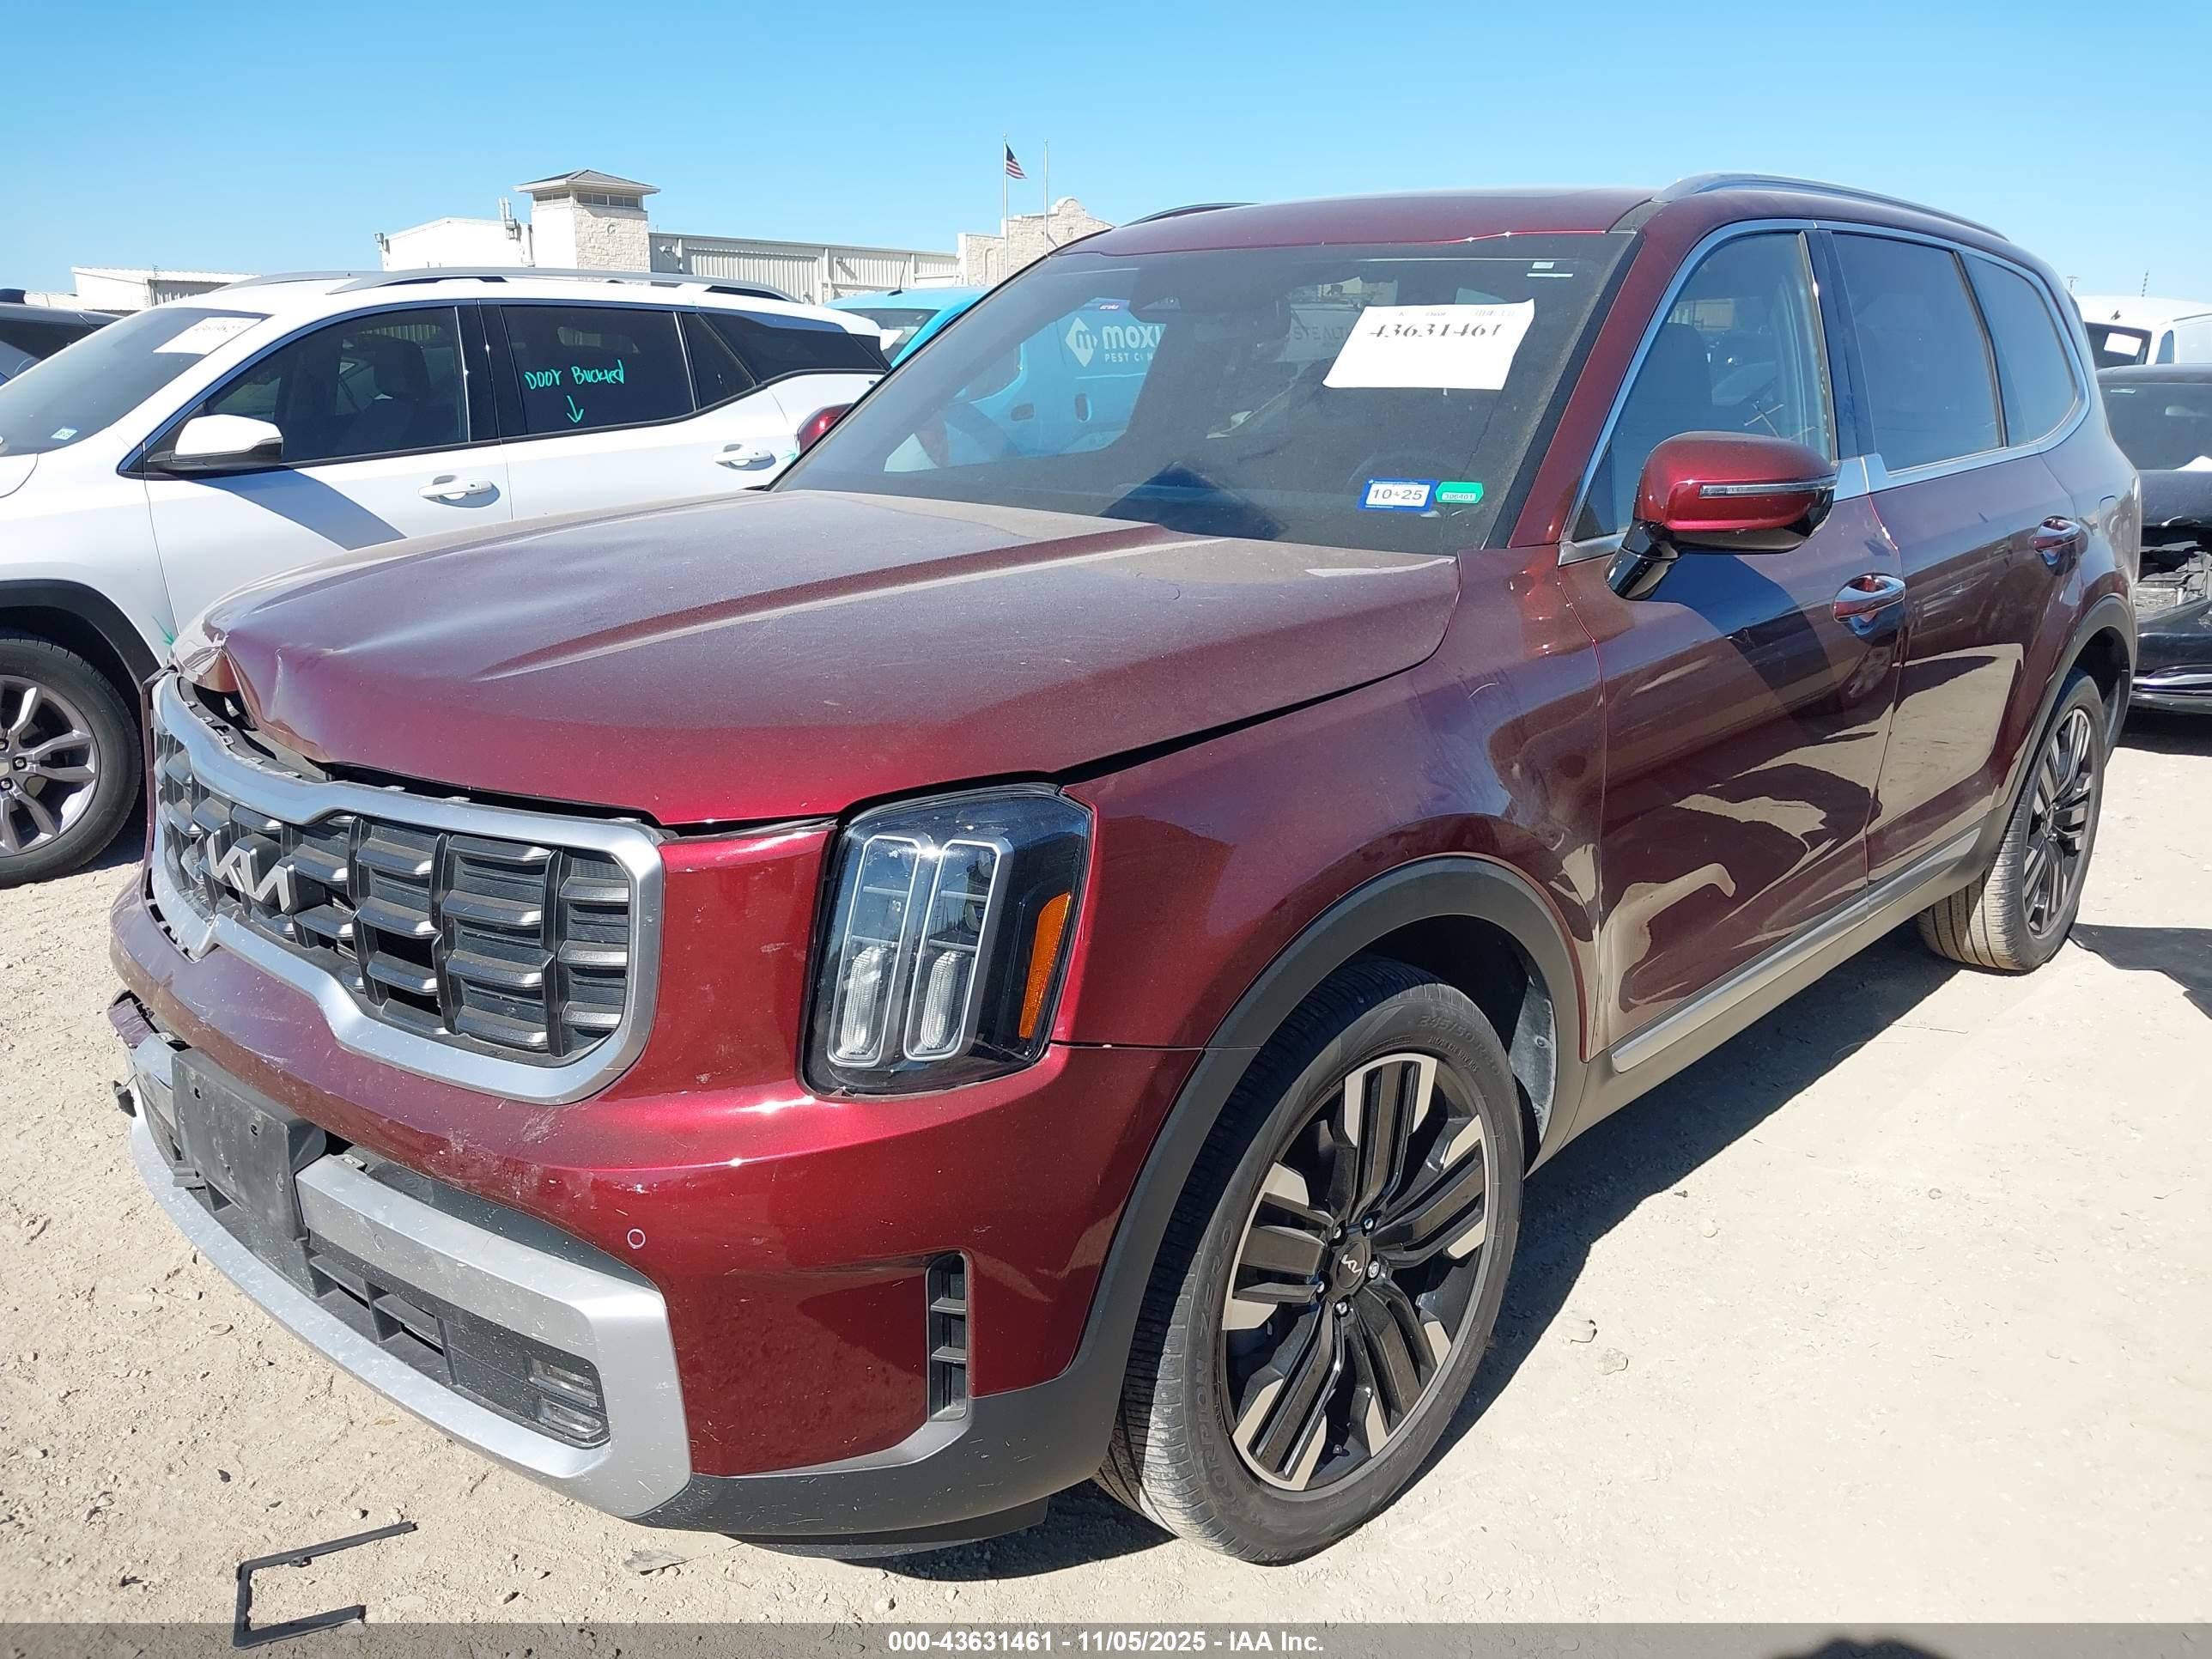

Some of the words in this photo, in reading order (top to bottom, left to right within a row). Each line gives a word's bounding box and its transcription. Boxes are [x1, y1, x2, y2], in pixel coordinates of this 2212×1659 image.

[1293, 326, 1349, 341] STEALT
[1369, 322, 1503, 338] 43631461
[1105, 353, 1128, 362] PEST
